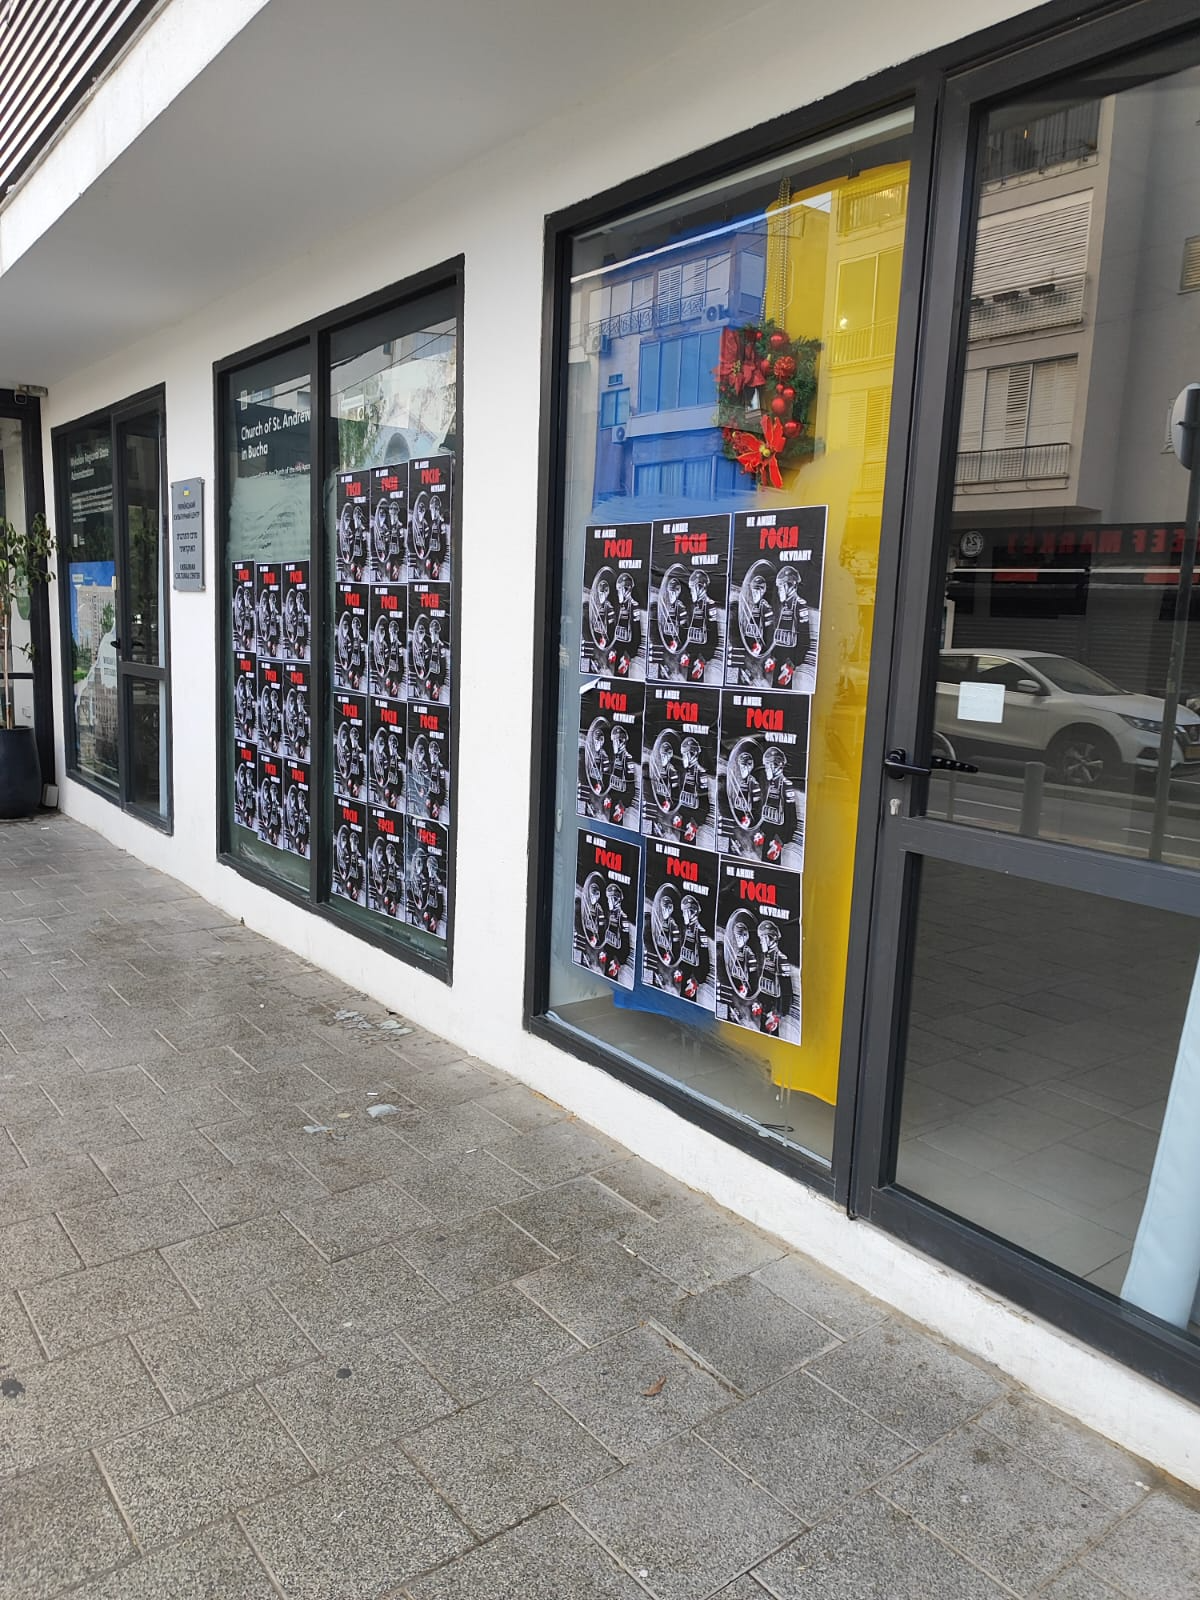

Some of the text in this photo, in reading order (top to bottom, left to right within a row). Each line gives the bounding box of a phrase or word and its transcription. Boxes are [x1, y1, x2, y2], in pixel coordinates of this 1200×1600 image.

[241, 420, 263, 441] Church
[264, 417, 272, 434] of
[273, 415, 282, 431] St.
[241, 441, 268, 461] in Bucha
[604, 538, 632, 558] РОСІЯ
[674, 533, 708, 554] РОСІЯ
[760, 525, 799, 550] РОСІЯ
[599, 691, 627, 711] РОСІЯ
[666, 700, 698, 723] РОСІЯ
[746, 708, 784, 731] РОСІЯ
[595, 847, 622, 872] РОСІЯ
[666, 856, 699, 882] РОСІЯ
[739, 879, 777, 905] РОСІЯ
